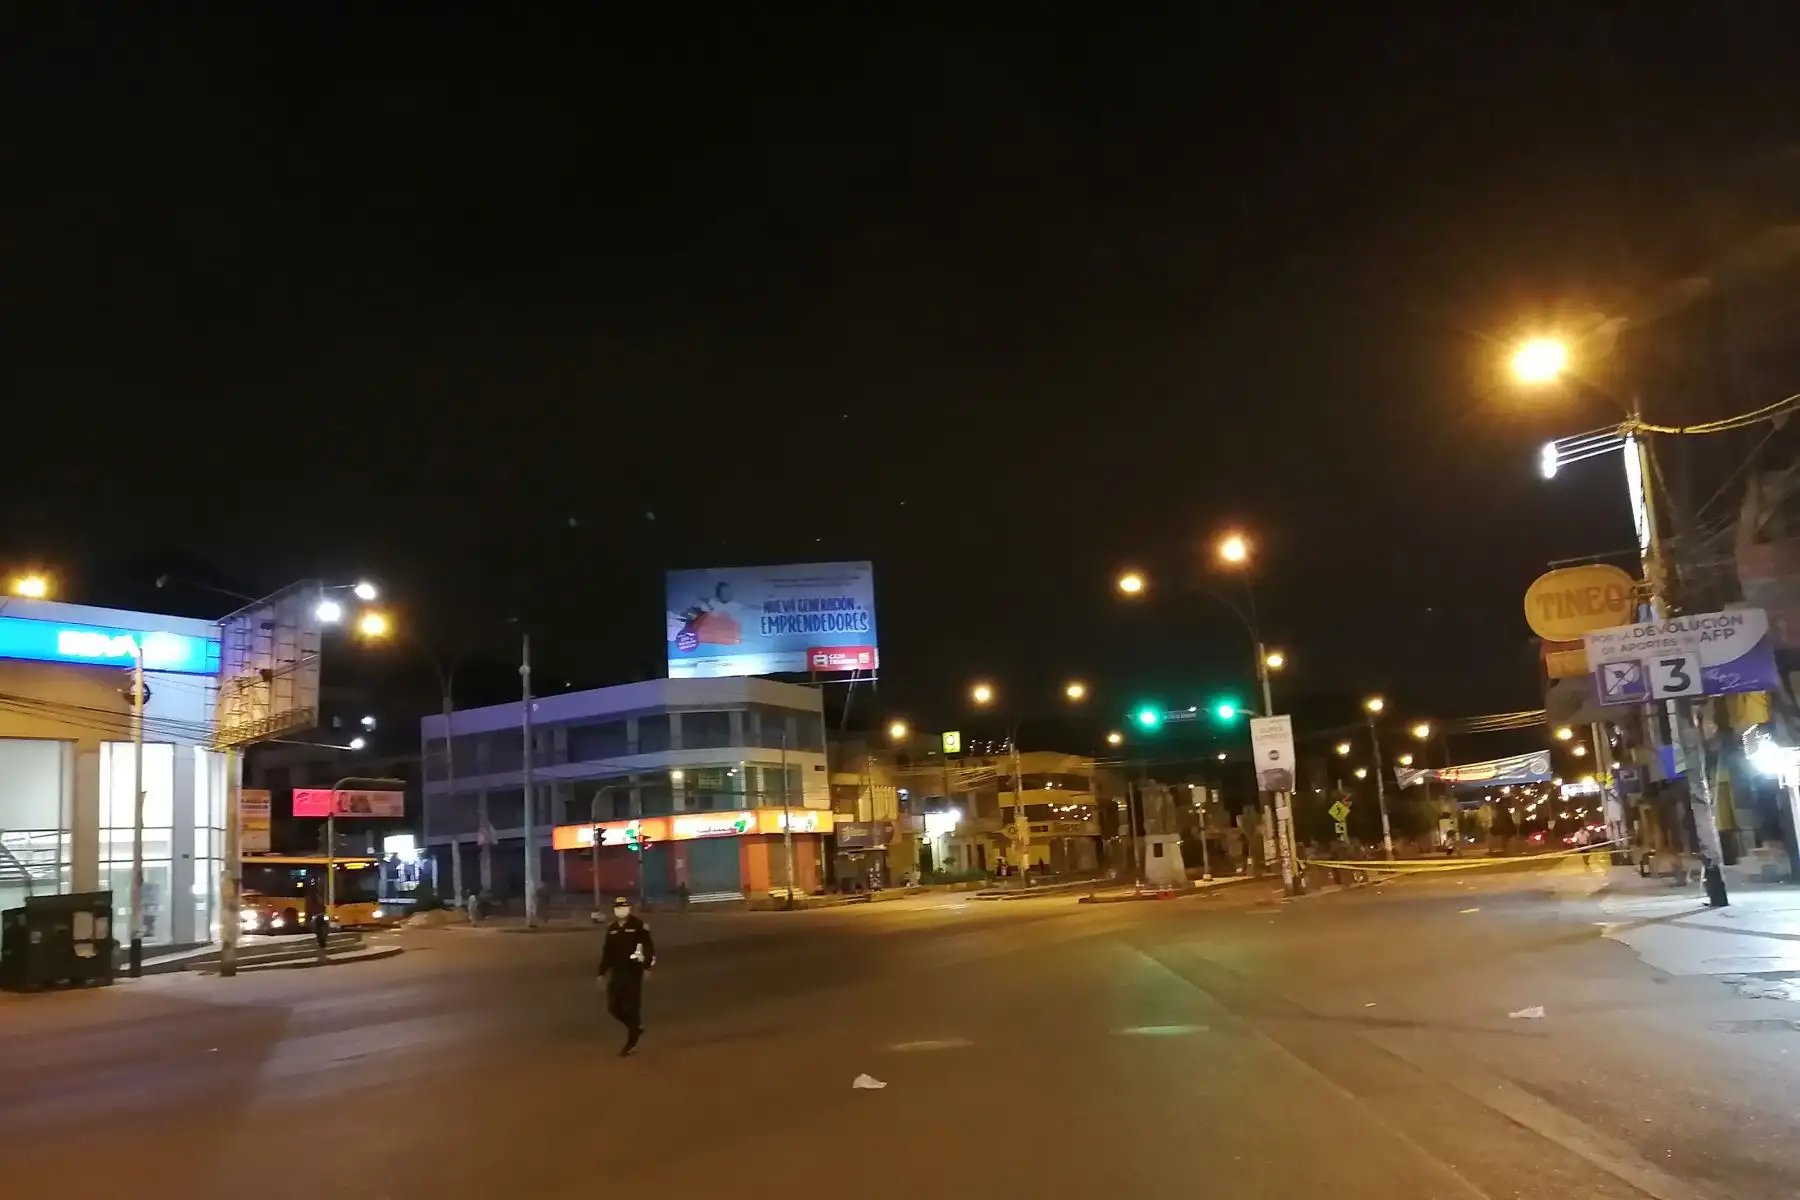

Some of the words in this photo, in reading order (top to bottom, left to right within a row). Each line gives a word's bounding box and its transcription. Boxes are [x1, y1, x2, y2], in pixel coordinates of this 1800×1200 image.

[1536, 583, 1625, 622] TINEO
[760, 612, 867, 635] EMPRENDEDORES
[1633, 613, 1744, 638] DEVOLUCIÓN
[1620, 638, 1677, 653] APORTES
[1700, 629, 1735, 643] AFP
[1660, 658, 1691, 692] 3
